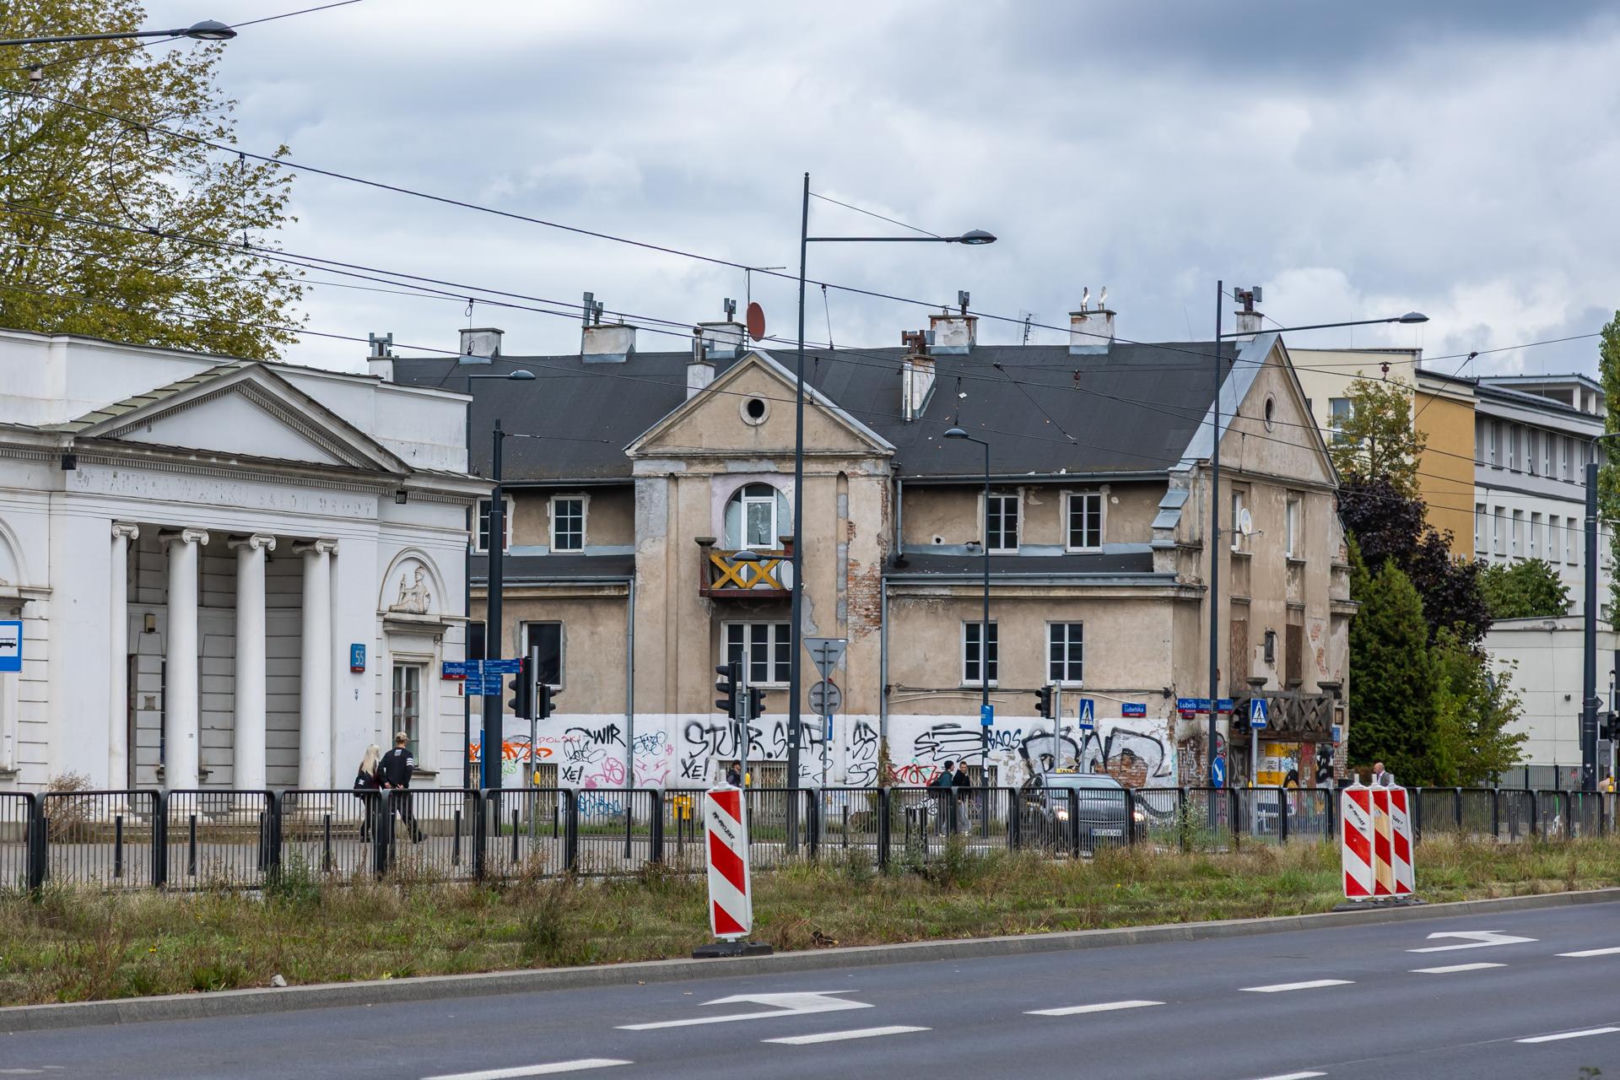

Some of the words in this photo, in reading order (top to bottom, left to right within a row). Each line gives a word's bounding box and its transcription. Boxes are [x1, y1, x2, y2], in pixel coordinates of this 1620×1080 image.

[355, 650, 364, 665] 55
[593, 723, 626, 747] WIR
[562, 765, 584, 784] XE!
